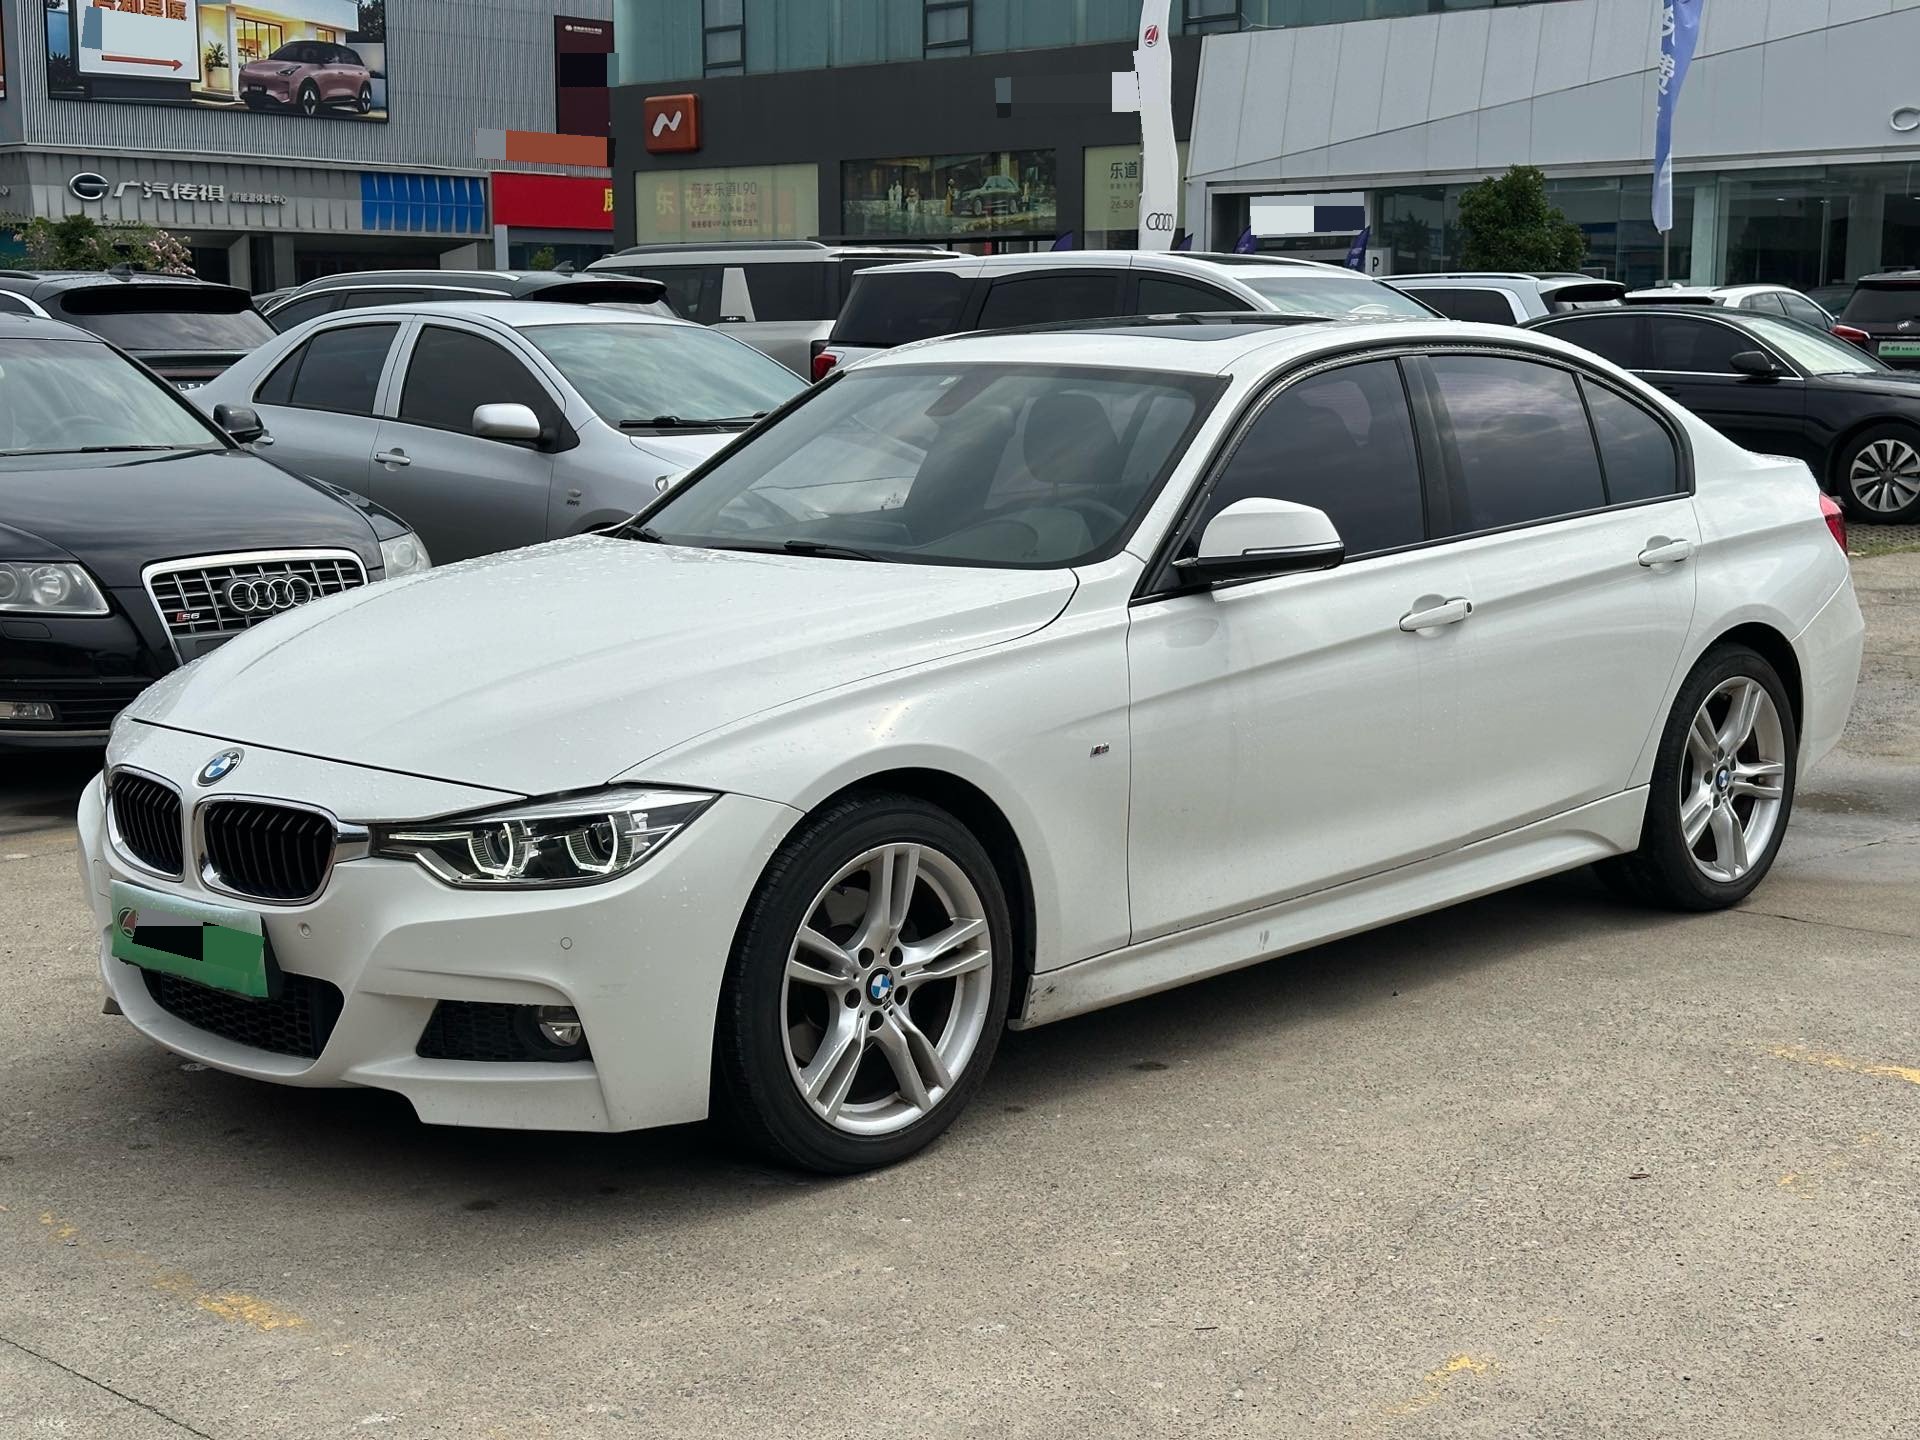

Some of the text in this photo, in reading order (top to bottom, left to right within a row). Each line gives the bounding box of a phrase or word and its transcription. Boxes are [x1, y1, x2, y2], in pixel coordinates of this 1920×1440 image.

[1110, 161, 1138, 179] 乐道
[112, 180, 225, 202] 广汽传祺
[1372, 256, 1380, 272] P
[183, 612, 200, 620] S6
